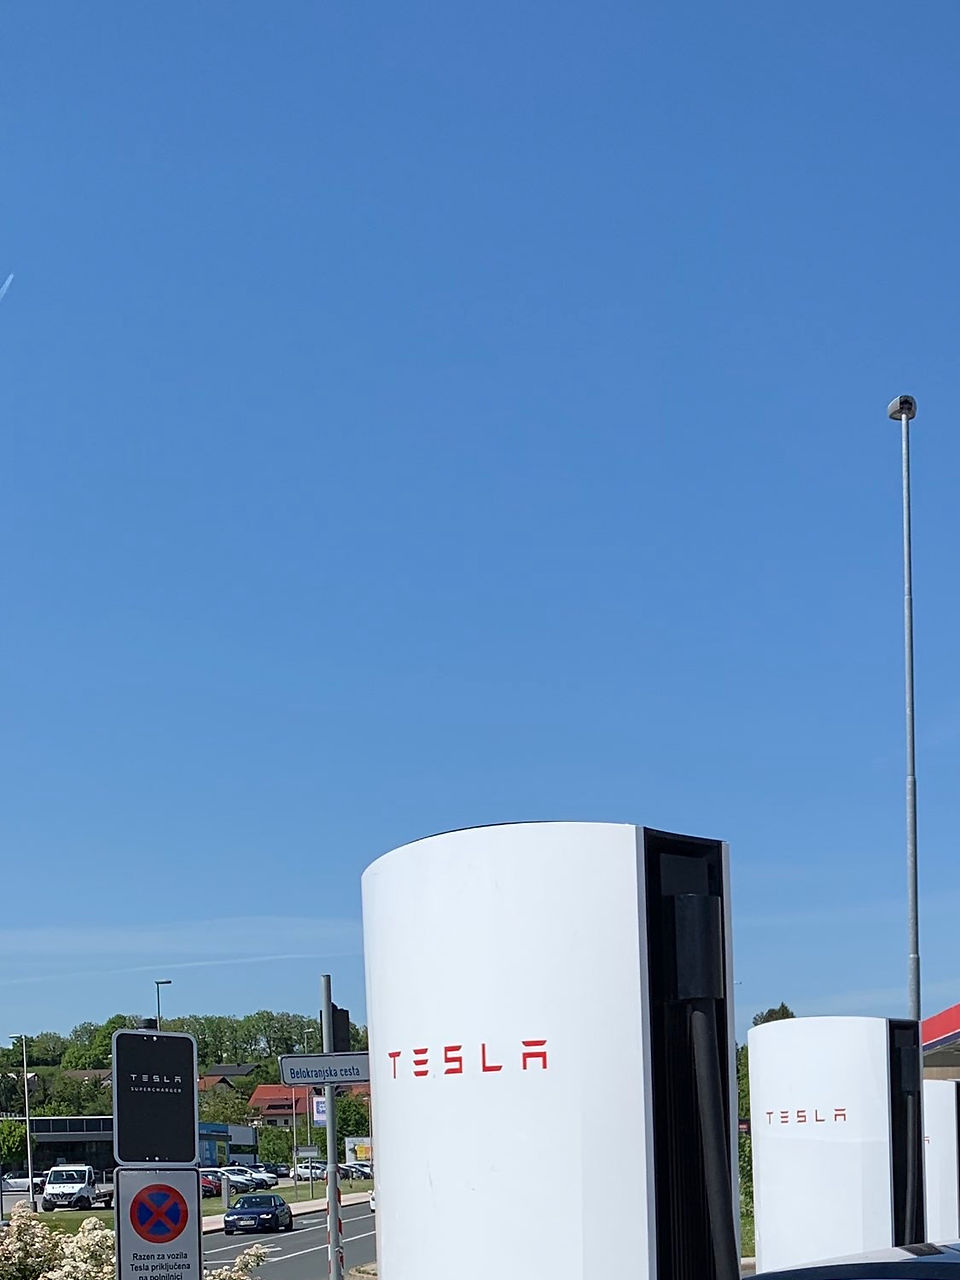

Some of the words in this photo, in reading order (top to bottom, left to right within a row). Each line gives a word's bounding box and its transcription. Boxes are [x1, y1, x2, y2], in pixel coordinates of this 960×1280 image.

[388, 1040, 547, 1079] TESLA
[130, 1074, 181, 1083] TESLA
[290, 1066, 338, 1080] Belokranjska
[339, 1066, 360, 1077] cesta
[766, 1108, 846, 1124] TESLA
[132, 1253, 155, 1261] Razen
[167, 1252, 188, 1260] vozila
[130, 1263, 149, 1272] Tesla
